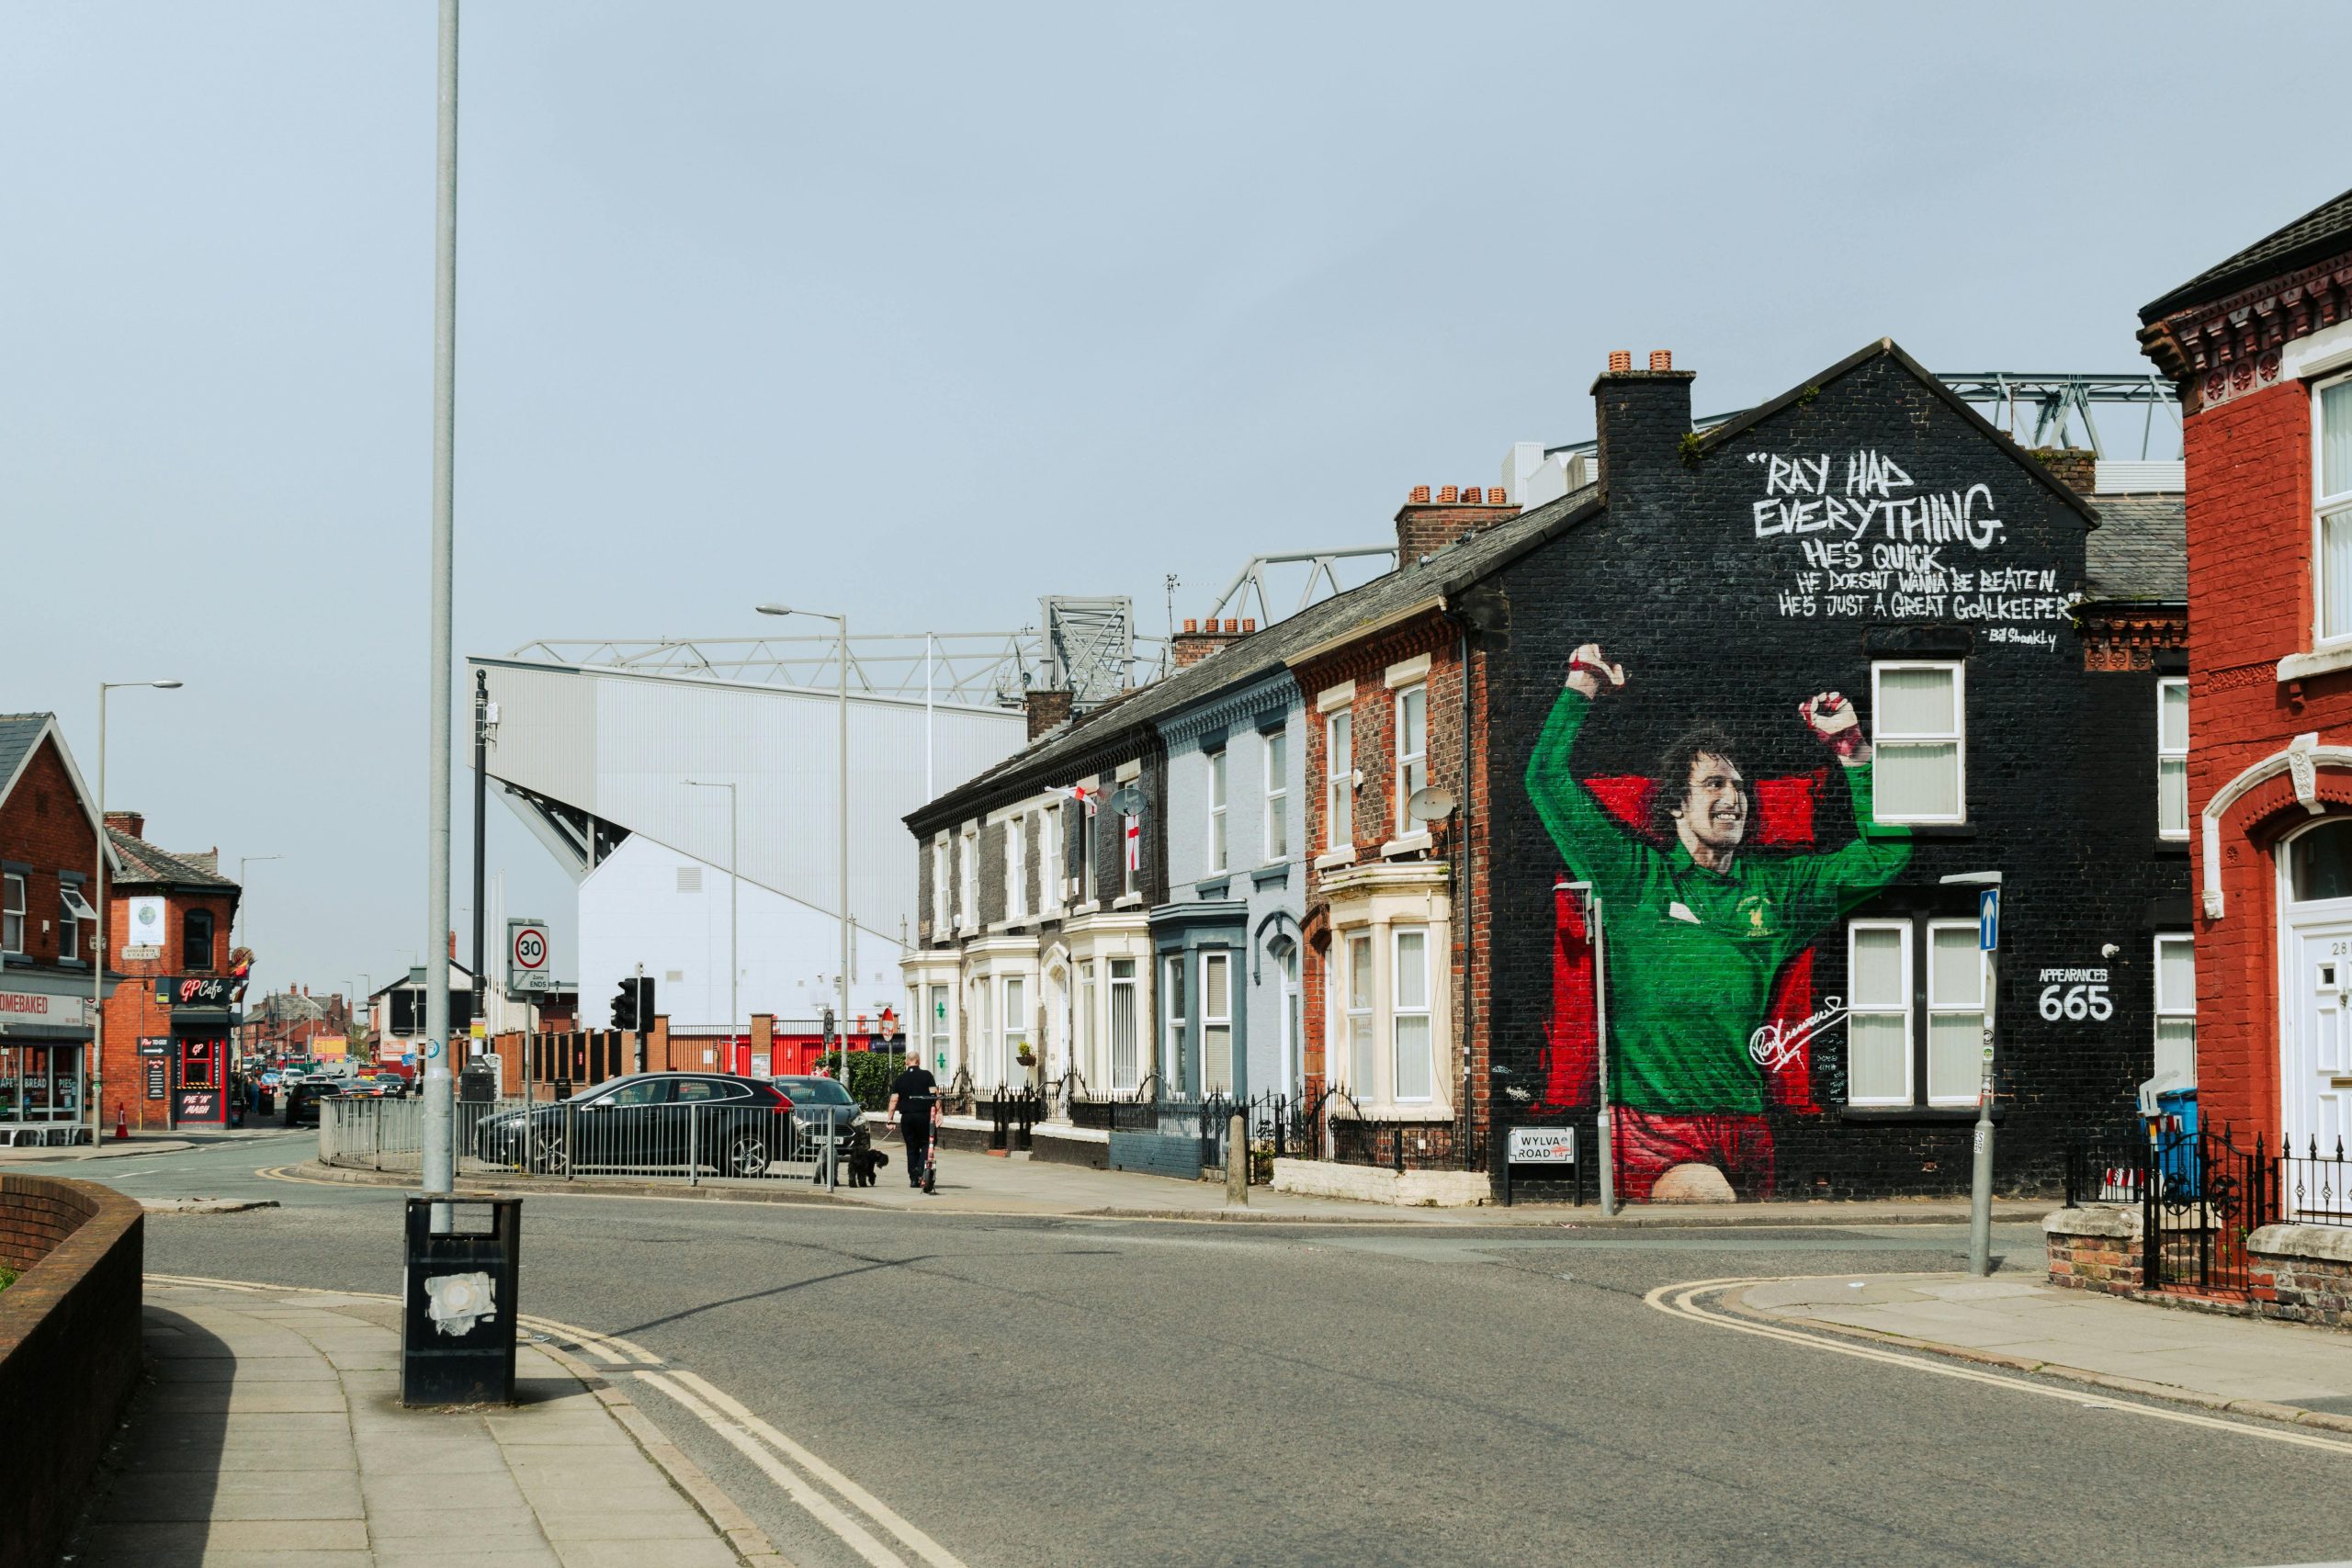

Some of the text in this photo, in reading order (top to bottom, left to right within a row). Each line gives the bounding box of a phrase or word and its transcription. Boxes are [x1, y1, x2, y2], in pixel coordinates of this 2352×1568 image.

[1847, 449, 1914, 498] HAD
[1801, 538, 1862, 569] HE'S
[1796, 571, 1822, 594] HE
[1898, 571, 1949, 592] WANNA
[1950, 567, 1973, 592] BE
[1979, 567, 2059, 592] BEATEN.
[1824, 593, 1870, 616] JUST
[1873, 592, 1887, 617] A
[1891, 591, 1947, 618] GREAT
[521, 940, 541, 956] 30
[2039, 968, 2108, 983] APPEARANCES
[2039, 984, 2113, 1021] 665
[24, 1077, 47, 1089] BREAD
[58, 1078, 72, 1088] PIES
[184, 1095, 198, 1104] PIE
[185, 1105, 210, 1114] MASH
[1521, 1136, 1560, 1145] WYLVA
[1519, 1148, 1551, 1158] ROAD
